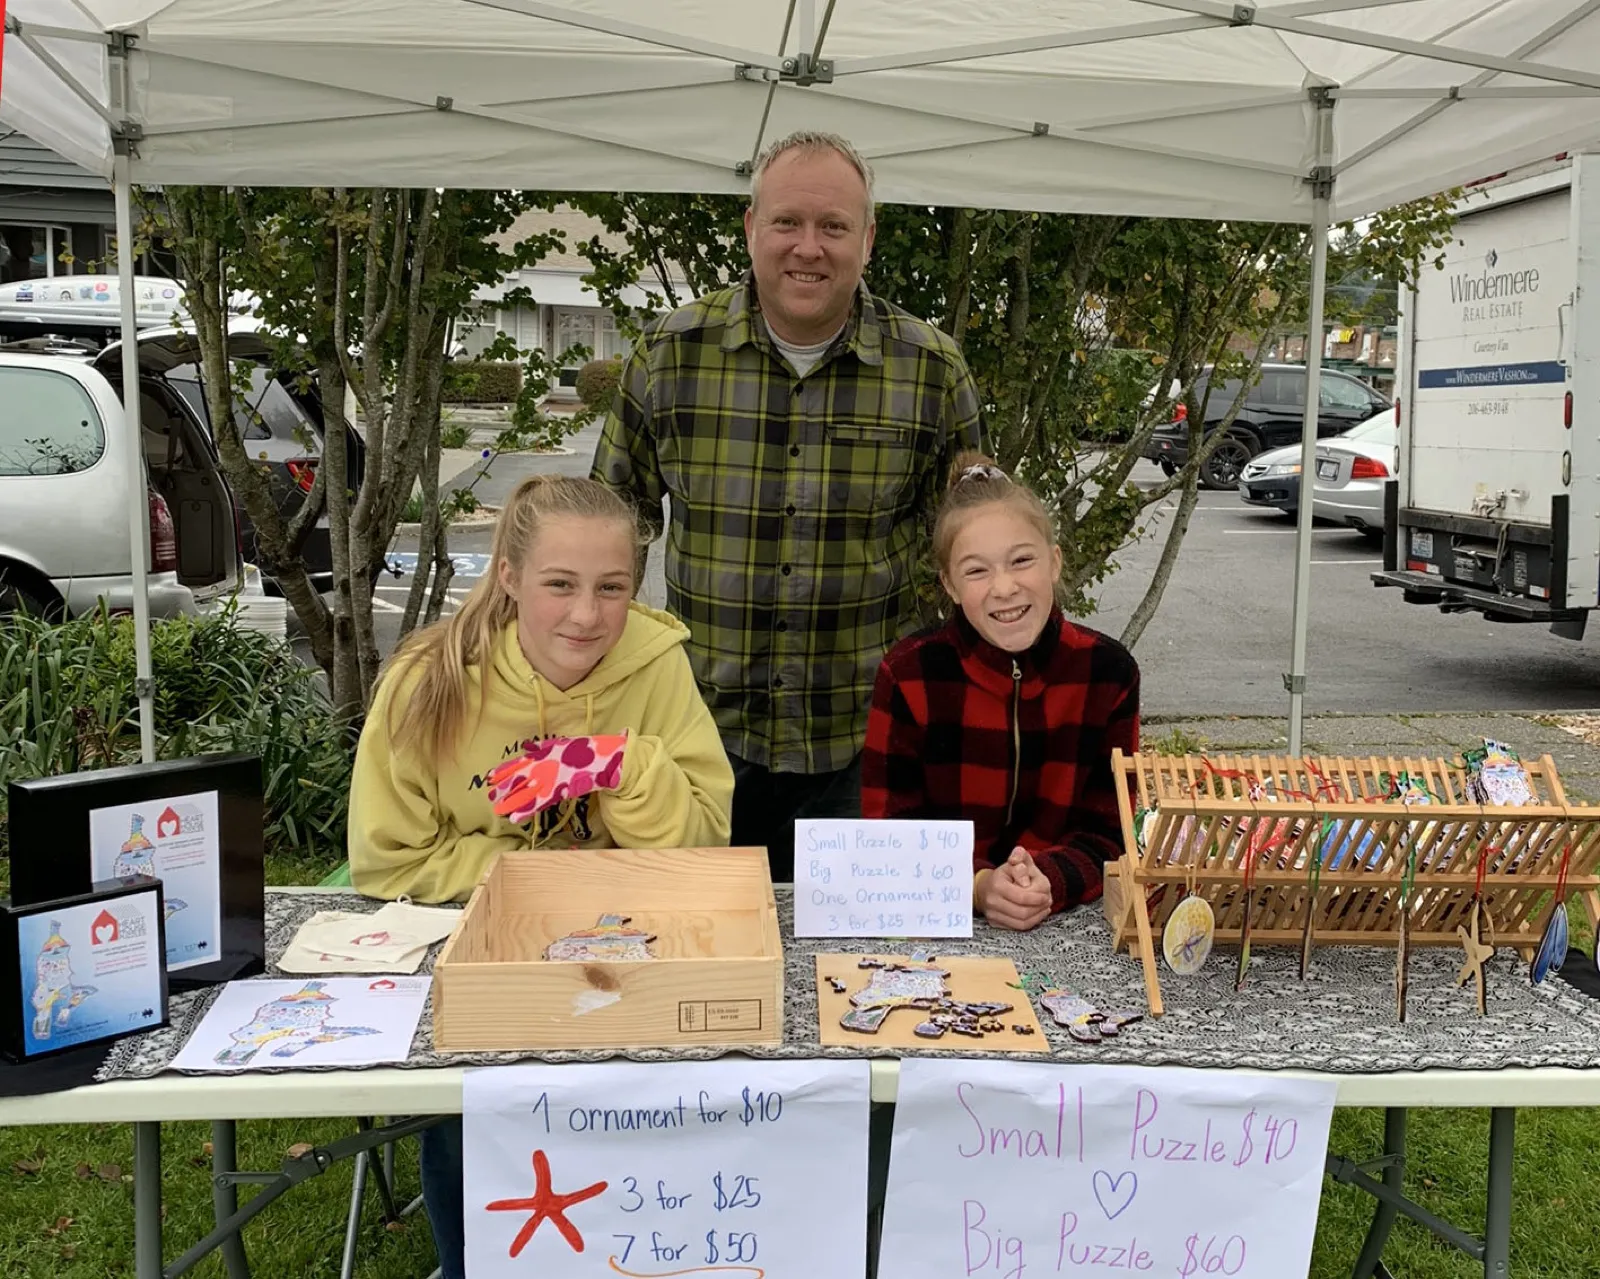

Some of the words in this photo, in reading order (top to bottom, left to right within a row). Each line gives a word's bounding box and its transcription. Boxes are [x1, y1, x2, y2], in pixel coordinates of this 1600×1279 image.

[1450, 268, 1540, 304] Windermere
[1463, 306, 1486, 322] REAL
[1490, 301, 1523, 319] ESTATE
[807, 827, 847, 851] Small
[855, 828, 902, 849] Puzzle
[937, 831, 959, 850] 40
[810, 860, 832, 884] Big
[851, 863, 900, 878] Puzzle
[931, 864, 954, 879] 60
[811, 889, 848, 905] One
[855, 887, 935, 903] Ornament
[829, 914, 840, 931] 3
[849, 915, 869, 930] for
[877, 914, 904, 930] $25
[946, 914, 968, 929] $50
[532, 1091, 551, 1133] 1
[569, 1095, 688, 1133] ornament
[697, 1090, 729, 1126] for
[738, 1086, 783, 1127] $10
[956, 1081, 1084, 1163] Small
[1130, 1087, 1226, 1163] Puzzle
[1233, 1107, 1298, 1167] $40
[619, 1176, 644, 1212] 3
[655, 1181, 693, 1211] for
[712, 1171, 762, 1214] $25
[612, 1234, 636, 1265] 7
[650, 1231, 688, 1263] for
[704, 1230, 758, 1265] $50
[962, 1199, 1027, 1279] Big
[1056, 1211, 1154, 1271] Puzzle
[1176, 1232, 1247, 1276] $60
